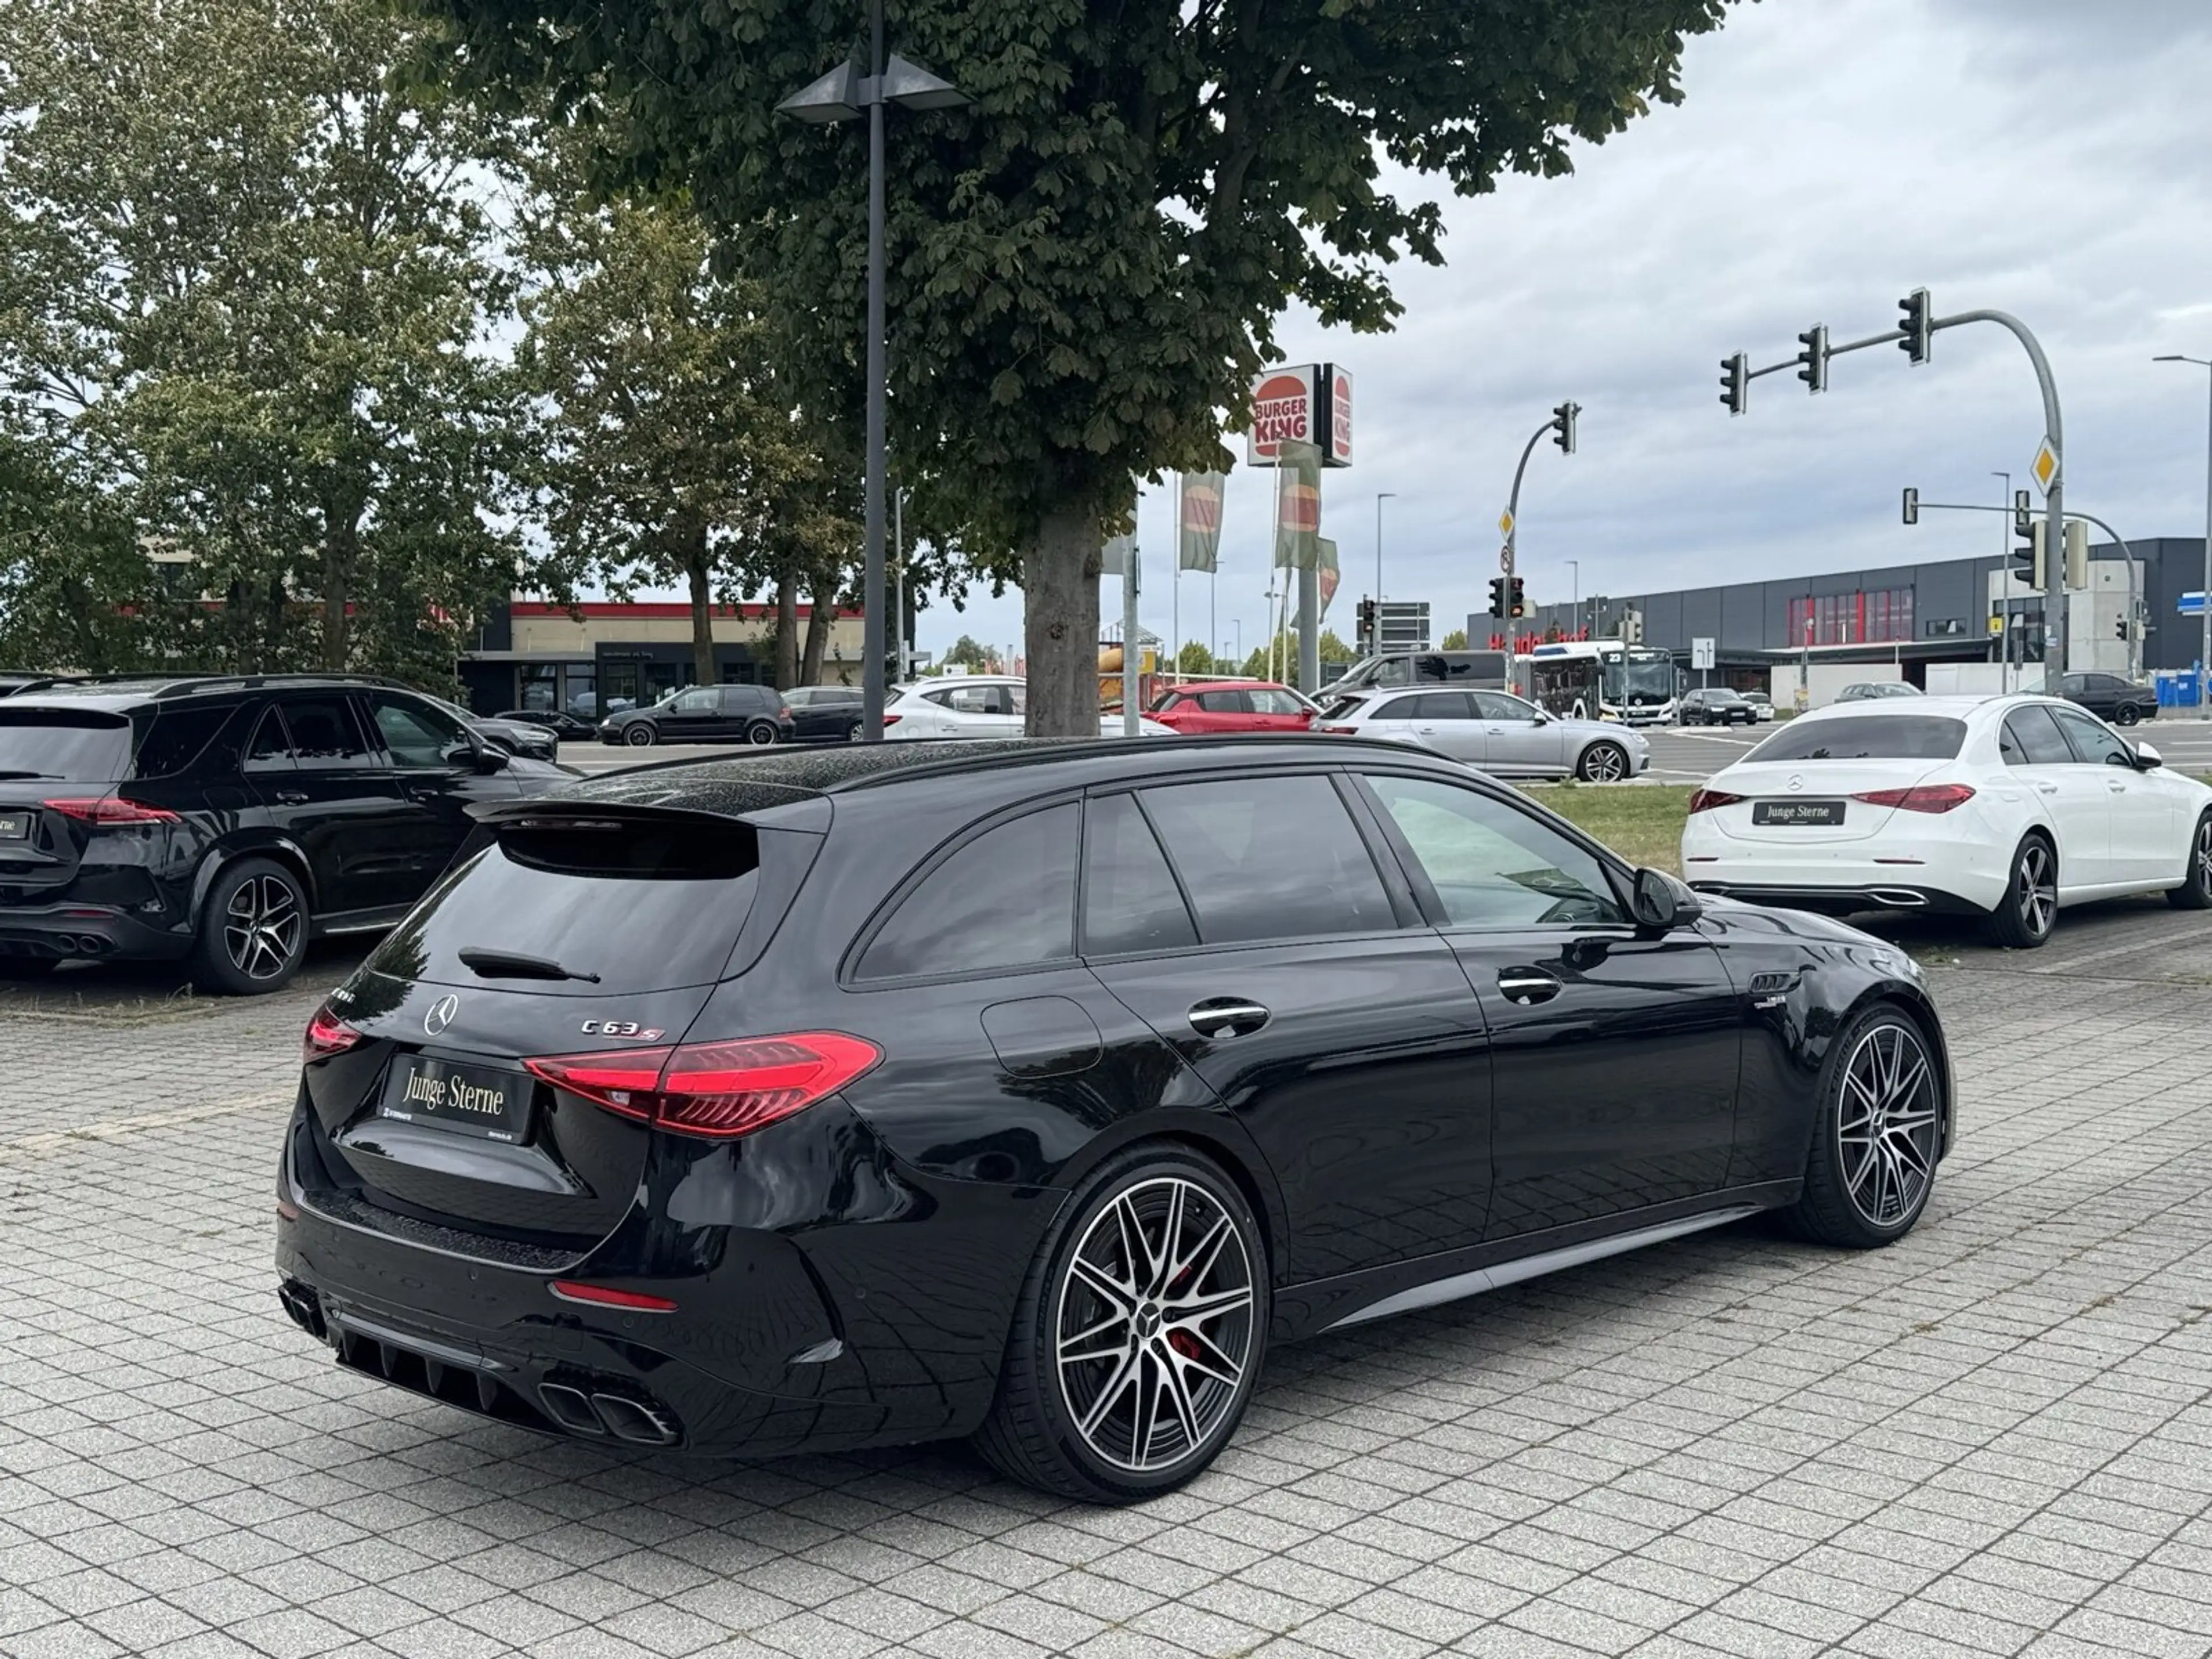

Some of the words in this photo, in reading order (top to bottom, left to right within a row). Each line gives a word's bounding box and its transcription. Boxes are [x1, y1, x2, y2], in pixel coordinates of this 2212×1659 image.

[1255, 398, 1307, 419] BURGER
[1255, 415, 1307, 444] KING
[1609, 653, 1622, 662] 23
[1767, 805, 1795, 820] Junge
[1796, 804, 1830, 817] Sterne
[403, 1067, 446, 1111] Junge
[447, 1074, 504, 1116] Sterne
